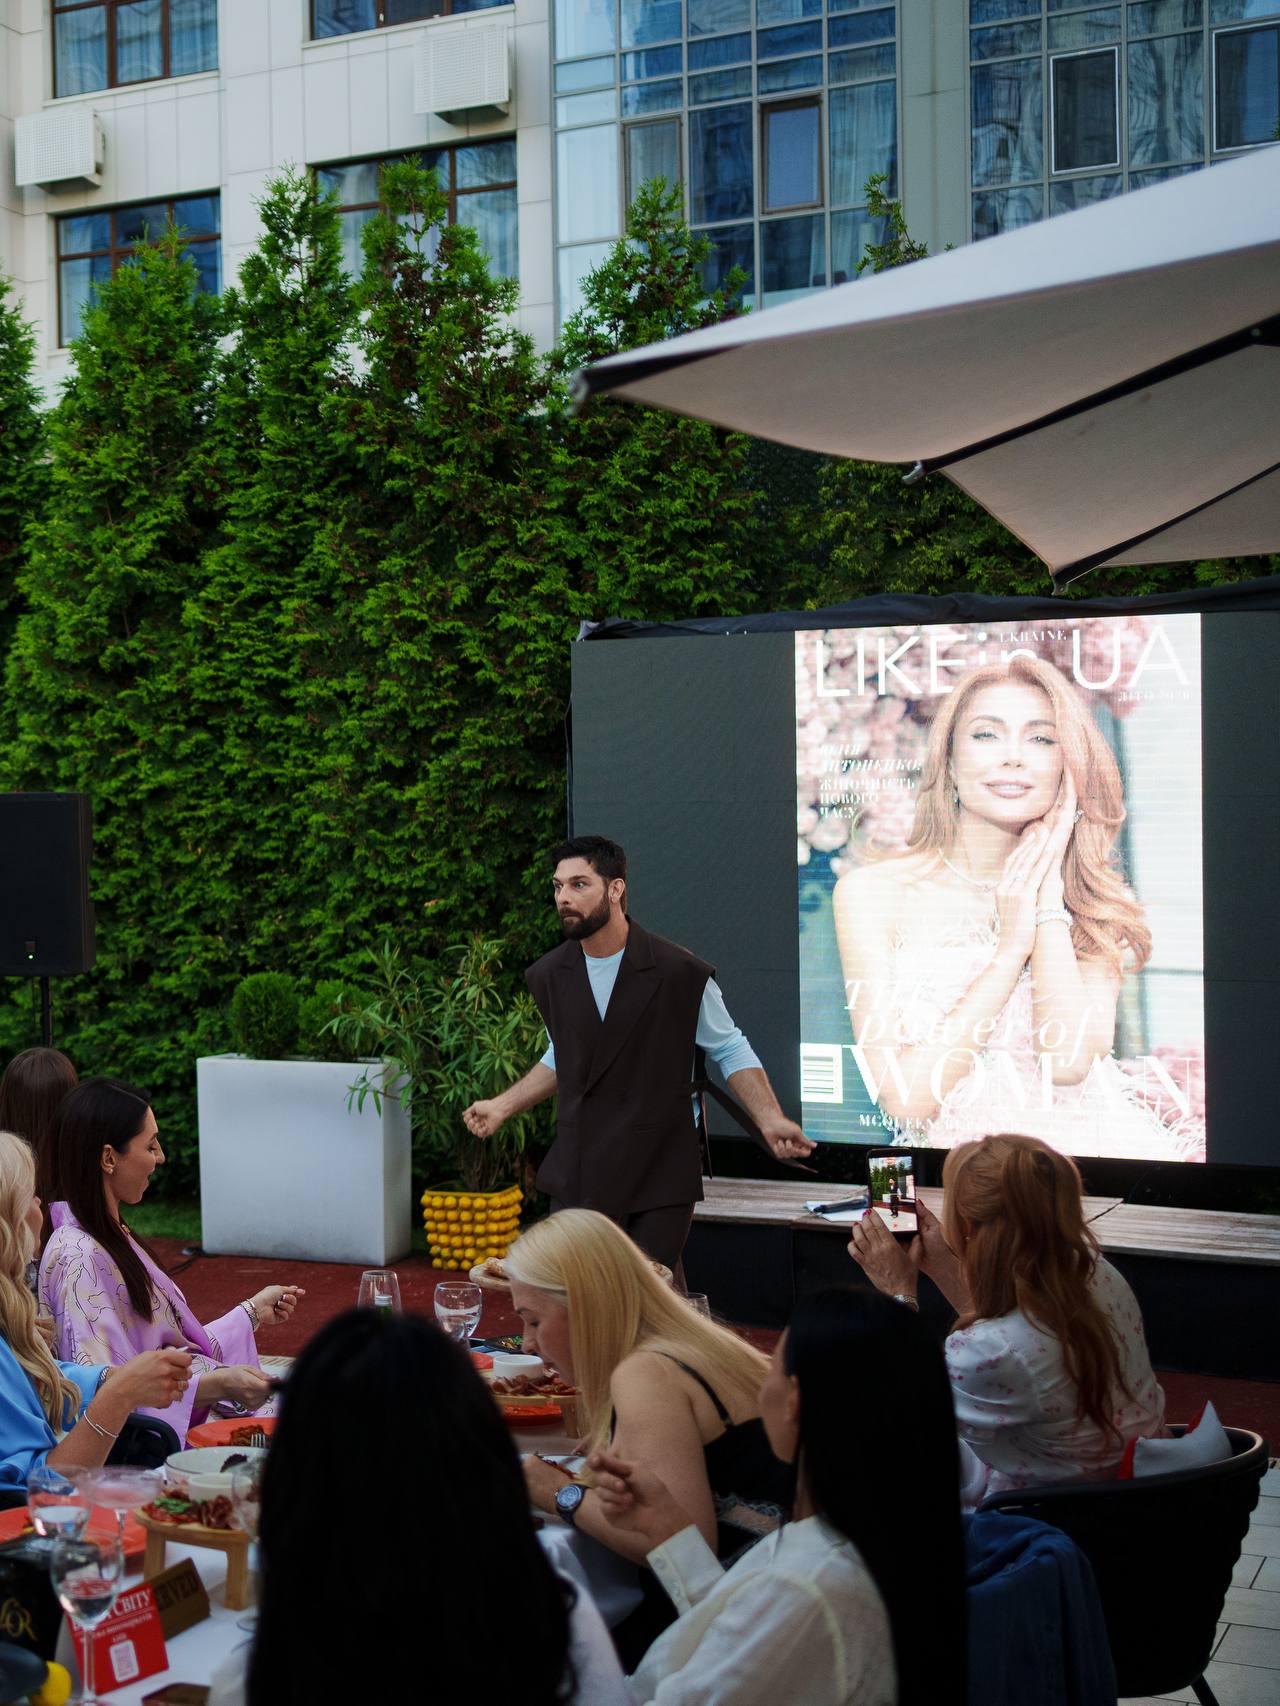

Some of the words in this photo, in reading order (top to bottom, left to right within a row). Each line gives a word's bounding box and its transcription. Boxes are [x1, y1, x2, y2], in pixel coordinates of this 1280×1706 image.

[816, 634, 967, 698] LIKE
[1072, 625, 1192, 691] UA
[820, 792, 879, 805] НОВОГО
[1035, 1002, 1105, 1068] of
[842, 1043, 1200, 1117] WOMAN
[113, 1588, 151, 1617] СВІТУ
